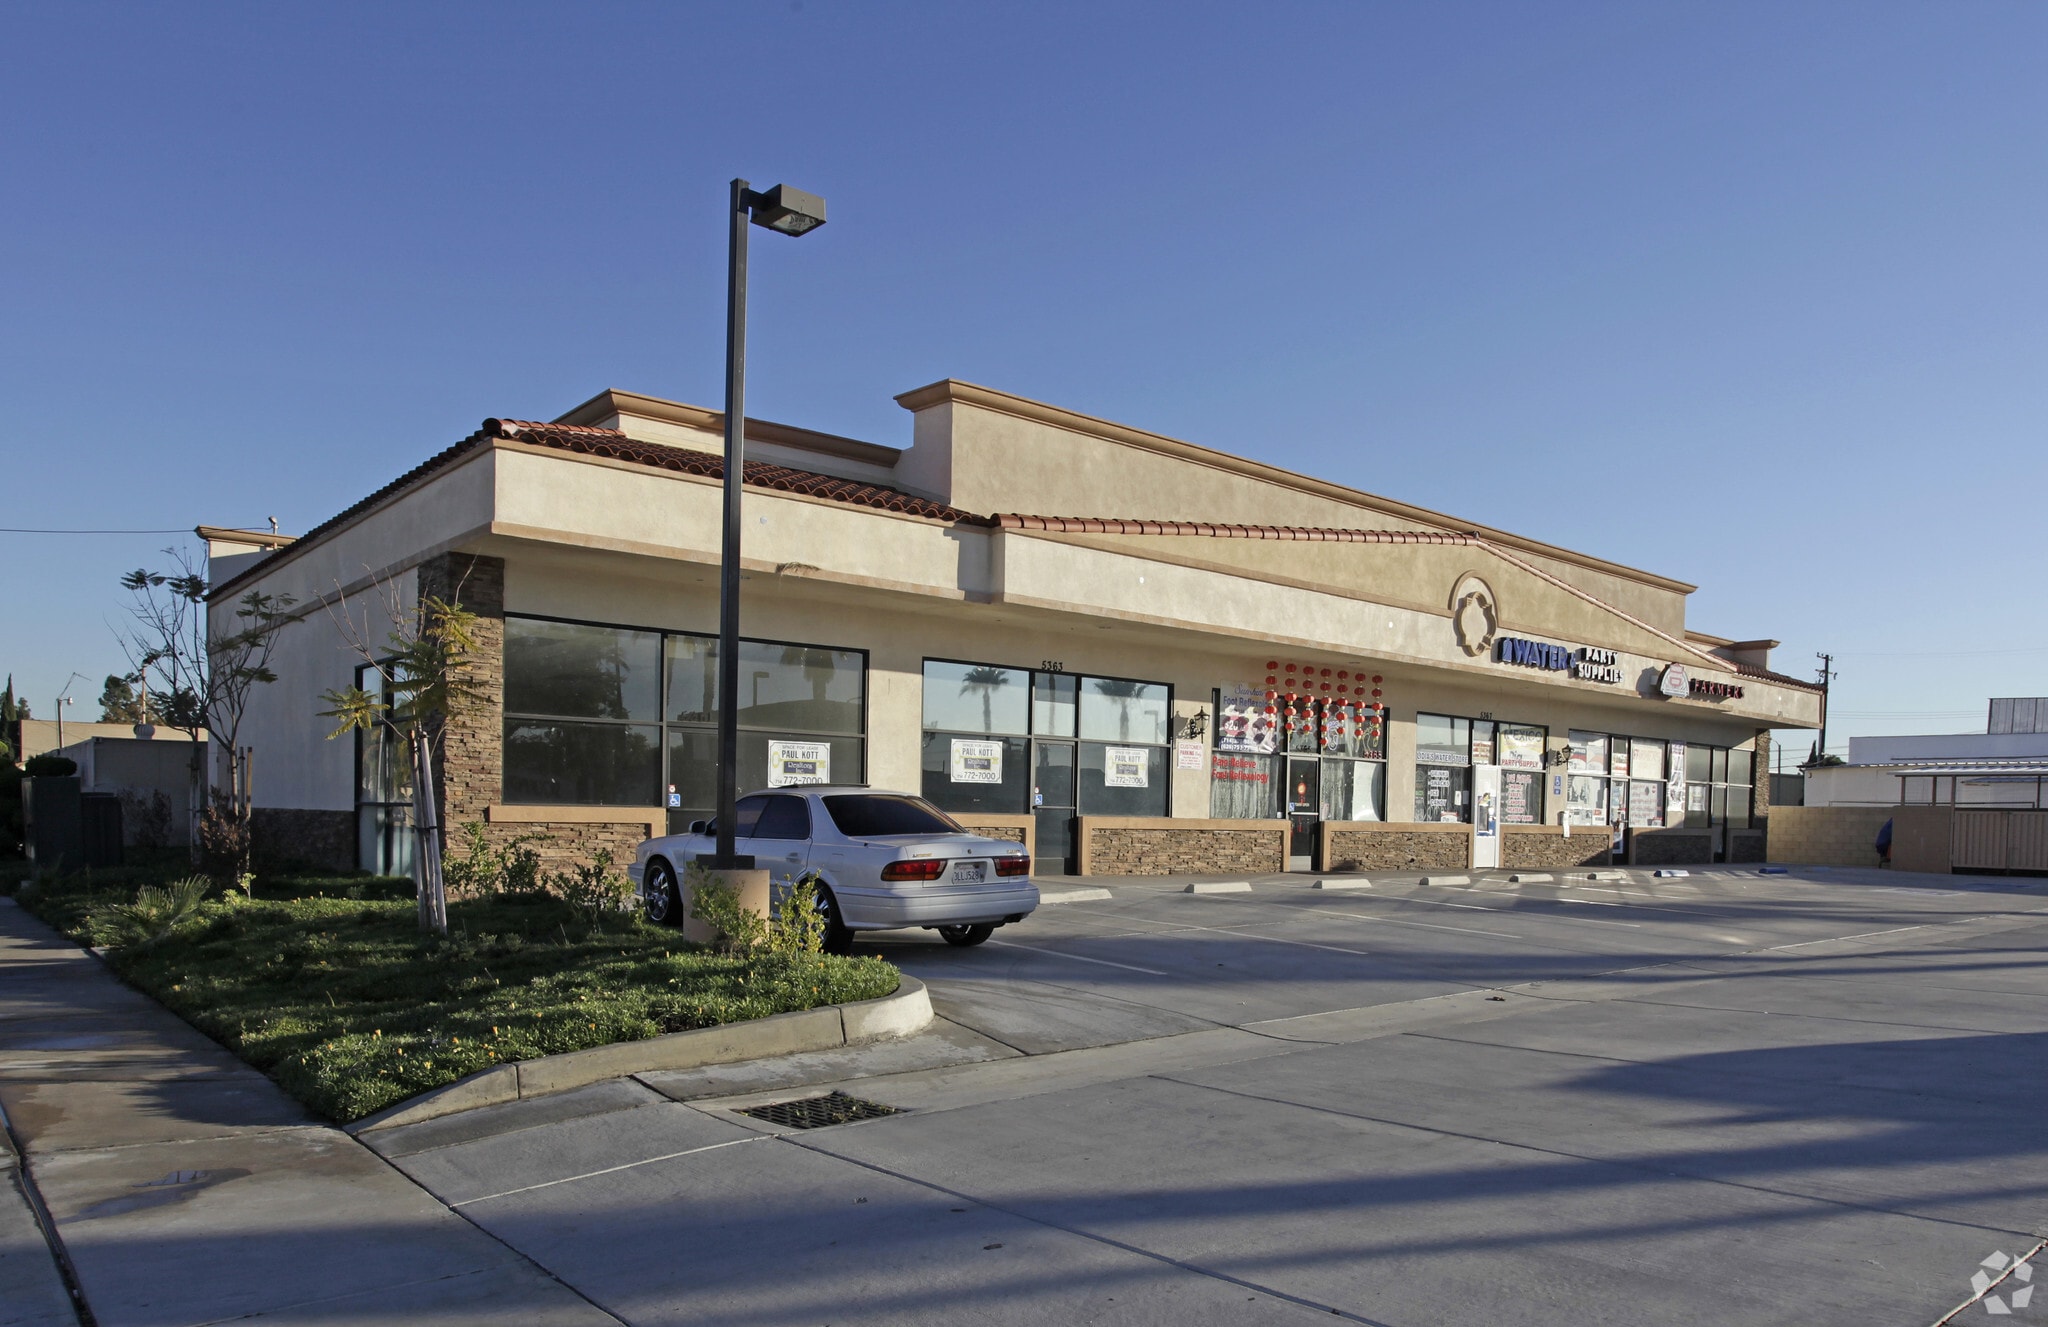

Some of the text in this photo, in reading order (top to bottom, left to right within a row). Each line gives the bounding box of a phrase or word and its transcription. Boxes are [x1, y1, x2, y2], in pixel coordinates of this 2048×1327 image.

[1513, 638, 1568, 670] WATER
[1585, 647, 1618, 665] PARTY
[1042, 660, 1063, 671] 5363
[1578, 663, 1625, 683] SUPPLIES
[1695, 680, 1746, 699] FARMERS
[1223, 696, 1238, 705] Foot
[1480, 712, 1493, 720] 5367
[1503, 729, 1543, 743] MEXICO
[781, 750, 819, 759] PAUL KOTT
[962, 748, 994, 757] PAUL KOTT
[1501, 759, 1539, 768] PARTY SUPPLY
[783, 776, 823, 784] 772-7000
[963, 772, 996, 780] 772-7000
[1229, 770, 1269, 784] Reflexology
